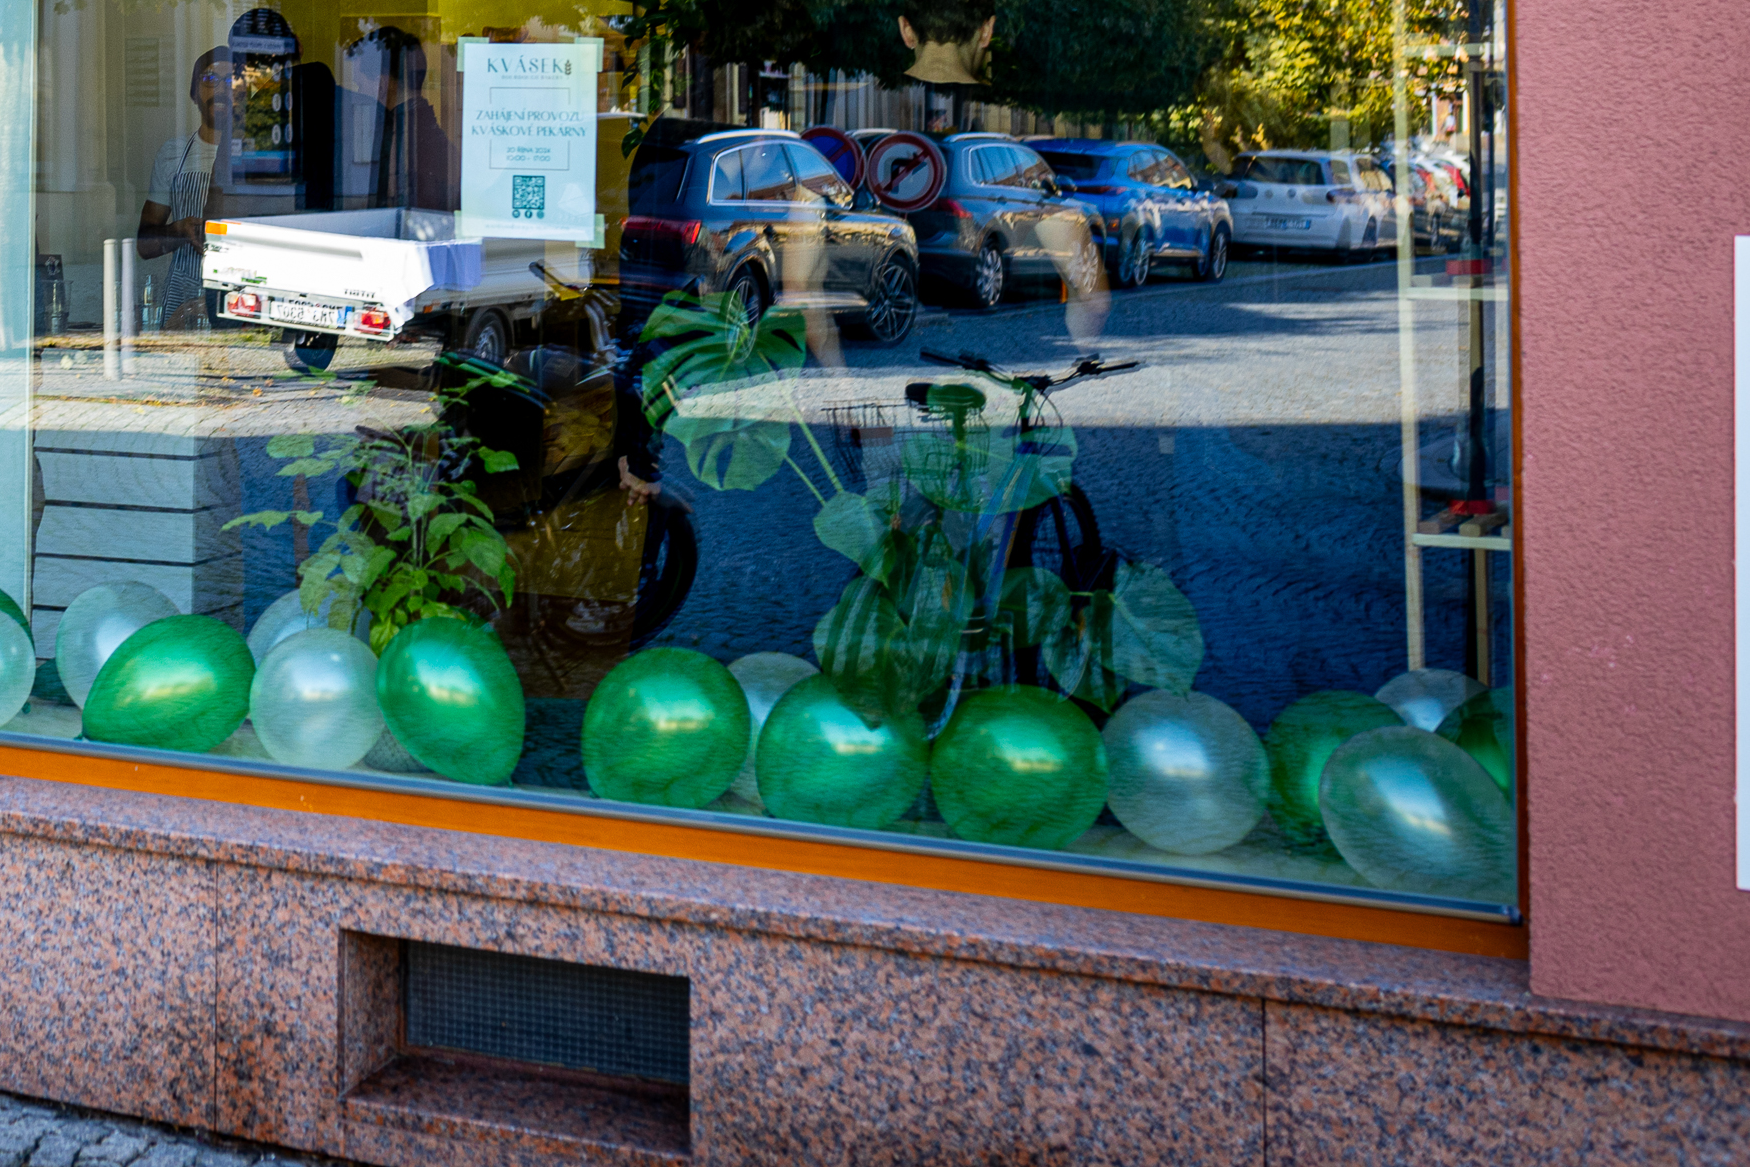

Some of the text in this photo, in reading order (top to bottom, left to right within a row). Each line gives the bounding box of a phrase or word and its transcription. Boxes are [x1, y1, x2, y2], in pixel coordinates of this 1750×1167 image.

[487, 55, 565, 73] KVÁSEK
[475, 107, 526, 122] ZAHÁJENÍ
[471, 122, 587, 137] KVÁSKOVÉ PEKÁRNY
